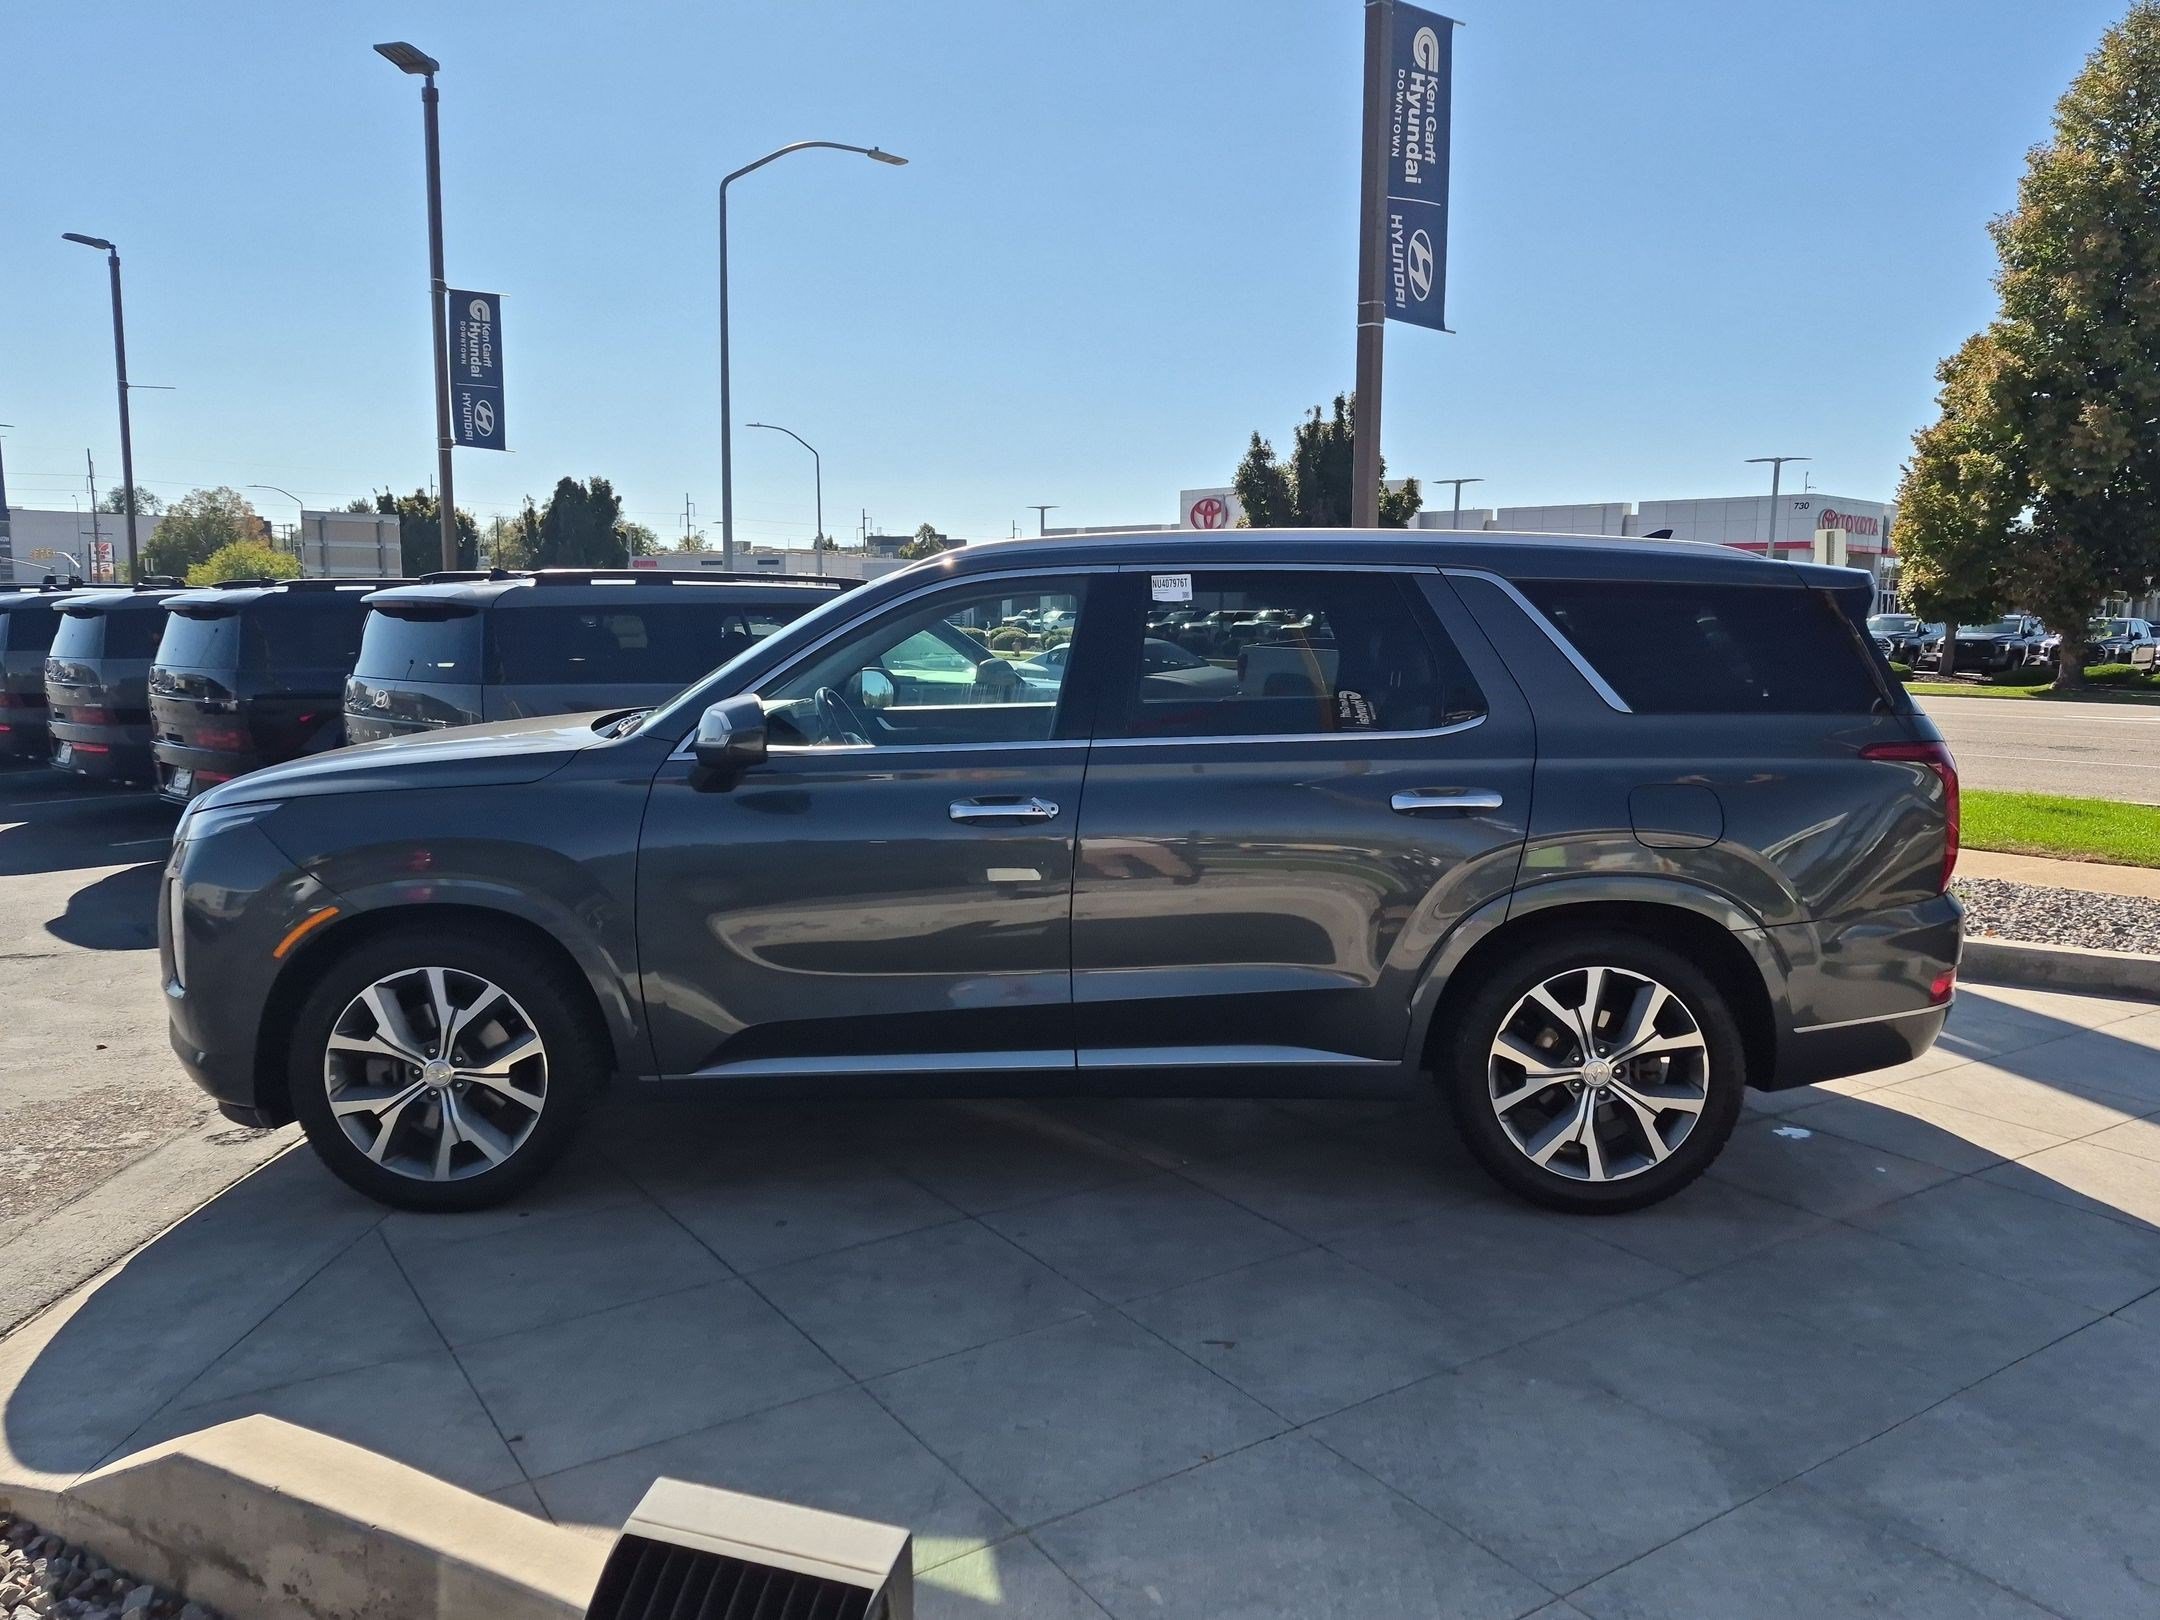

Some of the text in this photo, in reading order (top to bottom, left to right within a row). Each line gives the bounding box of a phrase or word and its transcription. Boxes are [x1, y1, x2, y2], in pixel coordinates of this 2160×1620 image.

[1391, 68, 1406, 157] DOWNTOWN
[1405, 71, 1426, 184] Hyundai
[1424, 76, 1439, 165] Ken Garff
[1390, 214, 1406, 309] HYUNDAI
[460, 320, 468, 365] DOWNTOWN
[468, 322, 483, 377] Hyundai
[482, 323, 493, 368] Ken Garff
[462, 392, 473, 440] HYUNDAI
[1794, 502, 1810, 510] 730
[1838, 514, 1879, 536] TOYOTA
[1153, 578, 1187, 588] NU407976T
